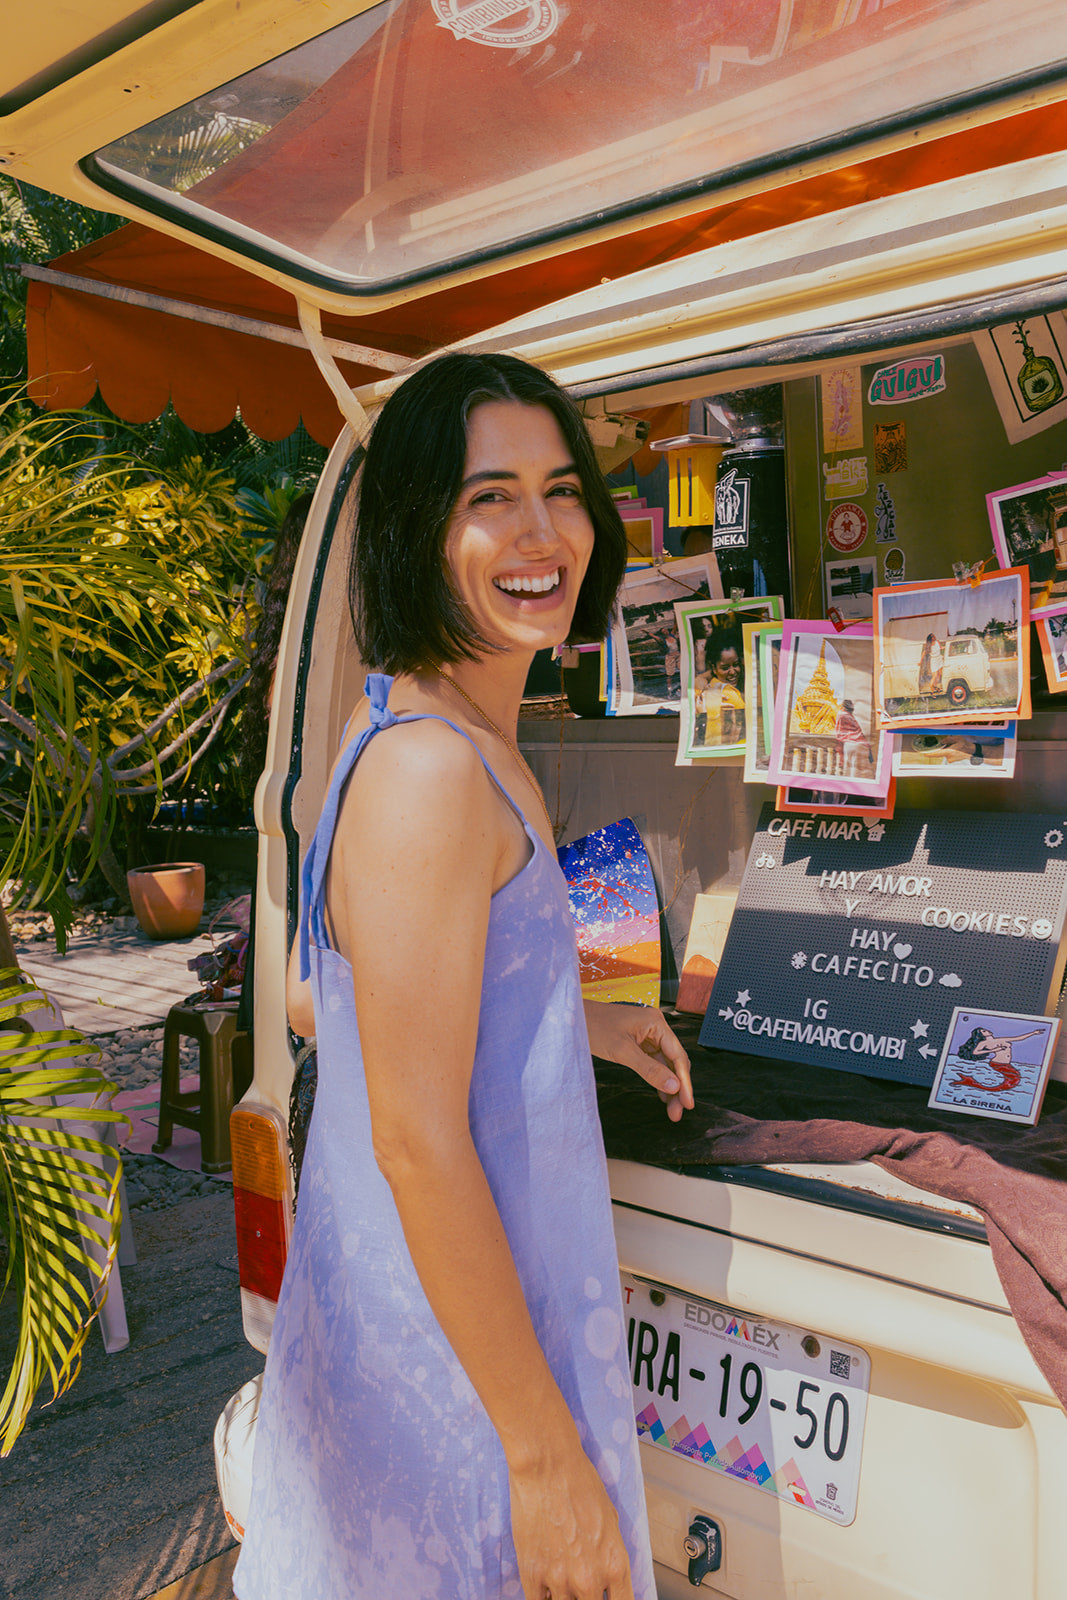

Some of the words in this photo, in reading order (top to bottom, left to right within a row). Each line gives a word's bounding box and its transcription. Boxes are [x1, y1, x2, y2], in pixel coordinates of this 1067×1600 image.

[871, 357, 942, 402] GUIGUI
[817, 821, 863, 840] MAR
[820, 870, 864, 891] HAY
[867, 874, 933, 897] AMOR
[845, 899, 860, 918] Y
[921, 907, 1028, 937] COOKIES
[850, 928, 897, 951] HAY
[811, 953, 934, 987] CAFECITO
[803, 998, 829, 1020] IG
[952, 1096, 968, 1105] LA
[970, 1099, 1012, 1112] SIRENA
